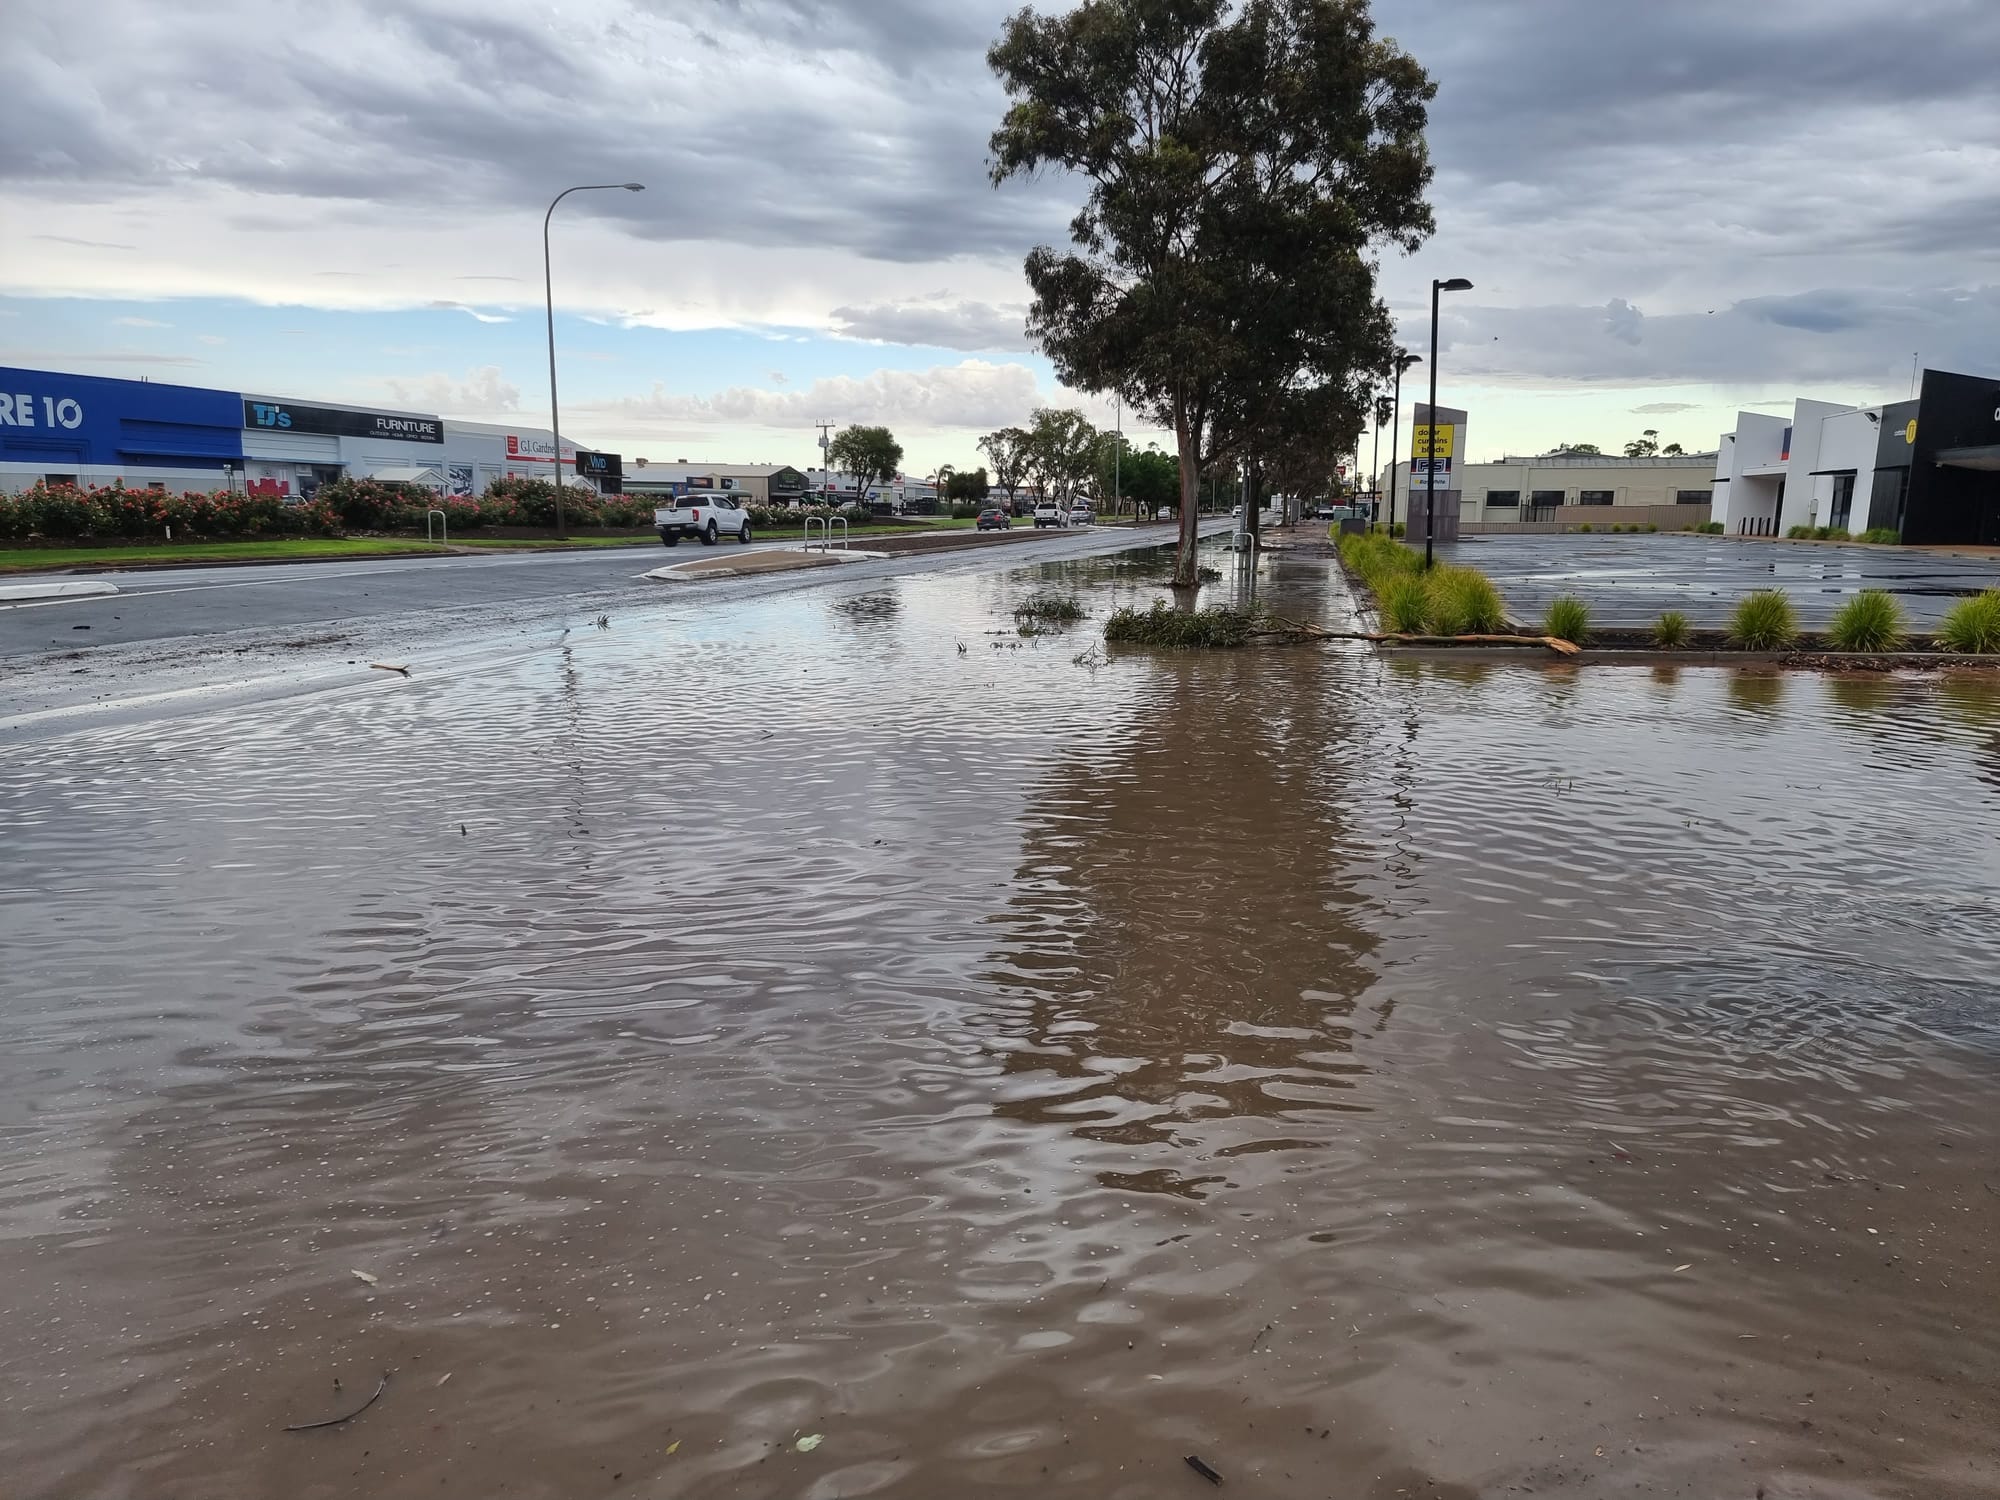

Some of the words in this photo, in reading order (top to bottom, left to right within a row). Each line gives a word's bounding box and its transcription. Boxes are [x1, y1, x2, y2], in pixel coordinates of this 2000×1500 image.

[43, 396, 83, 429] 10
[253, 405, 292, 427] TJ's
[377, 418, 436, 434] FURNITURE
[533, 441, 556, 455] Gardne
